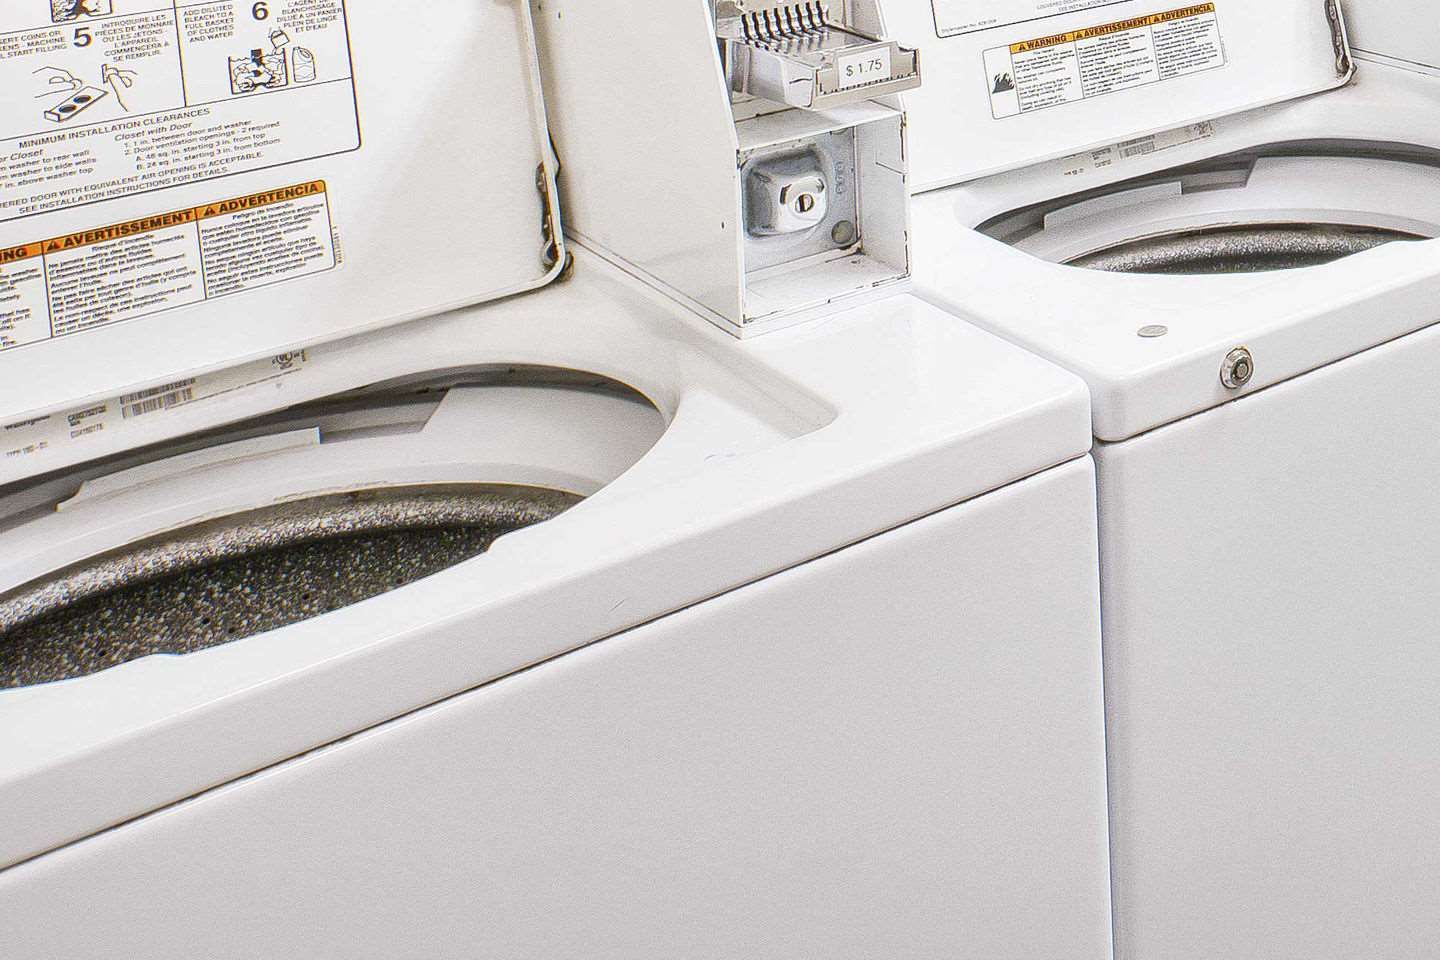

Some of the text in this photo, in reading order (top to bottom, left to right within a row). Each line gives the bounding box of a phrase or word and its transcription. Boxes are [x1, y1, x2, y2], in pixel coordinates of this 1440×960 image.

[251, 0, 269, 21] 6
[1160, 4, 1211, 20] ADVERTENCIA
[71, 26, 91, 48] 5
[1083, 17, 1148, 36] AVERTISSEMENT
[1027, 34, 1066, 49] WARNING
[846, 58, 883, 77] $ 1.75
[18, 108, 210, 148] MINIMUM INSTALLATION CLEARANCES
[114, 121, 192, 141] Closet with Door
[10, 148, 43, 160] Closet
[30, 192, 56, 202] DOOR
[59, 187, 81, 197] WITH
[84, 175, 139, 192] EQUIVALENT
[141, 172, 156, 180] AIR
[158, 164, 196, 177] OPENING
[208, 150, 263, 167] ACCEPTABLE.
[19, 166, 228, 214] SEE INSTALLATION INSTRUCTIONS FOR DETAILS.
[218, 183, 317, 212] ADVERTENCIA
[62, 211, 190, 247] AVERTISSEMENT
